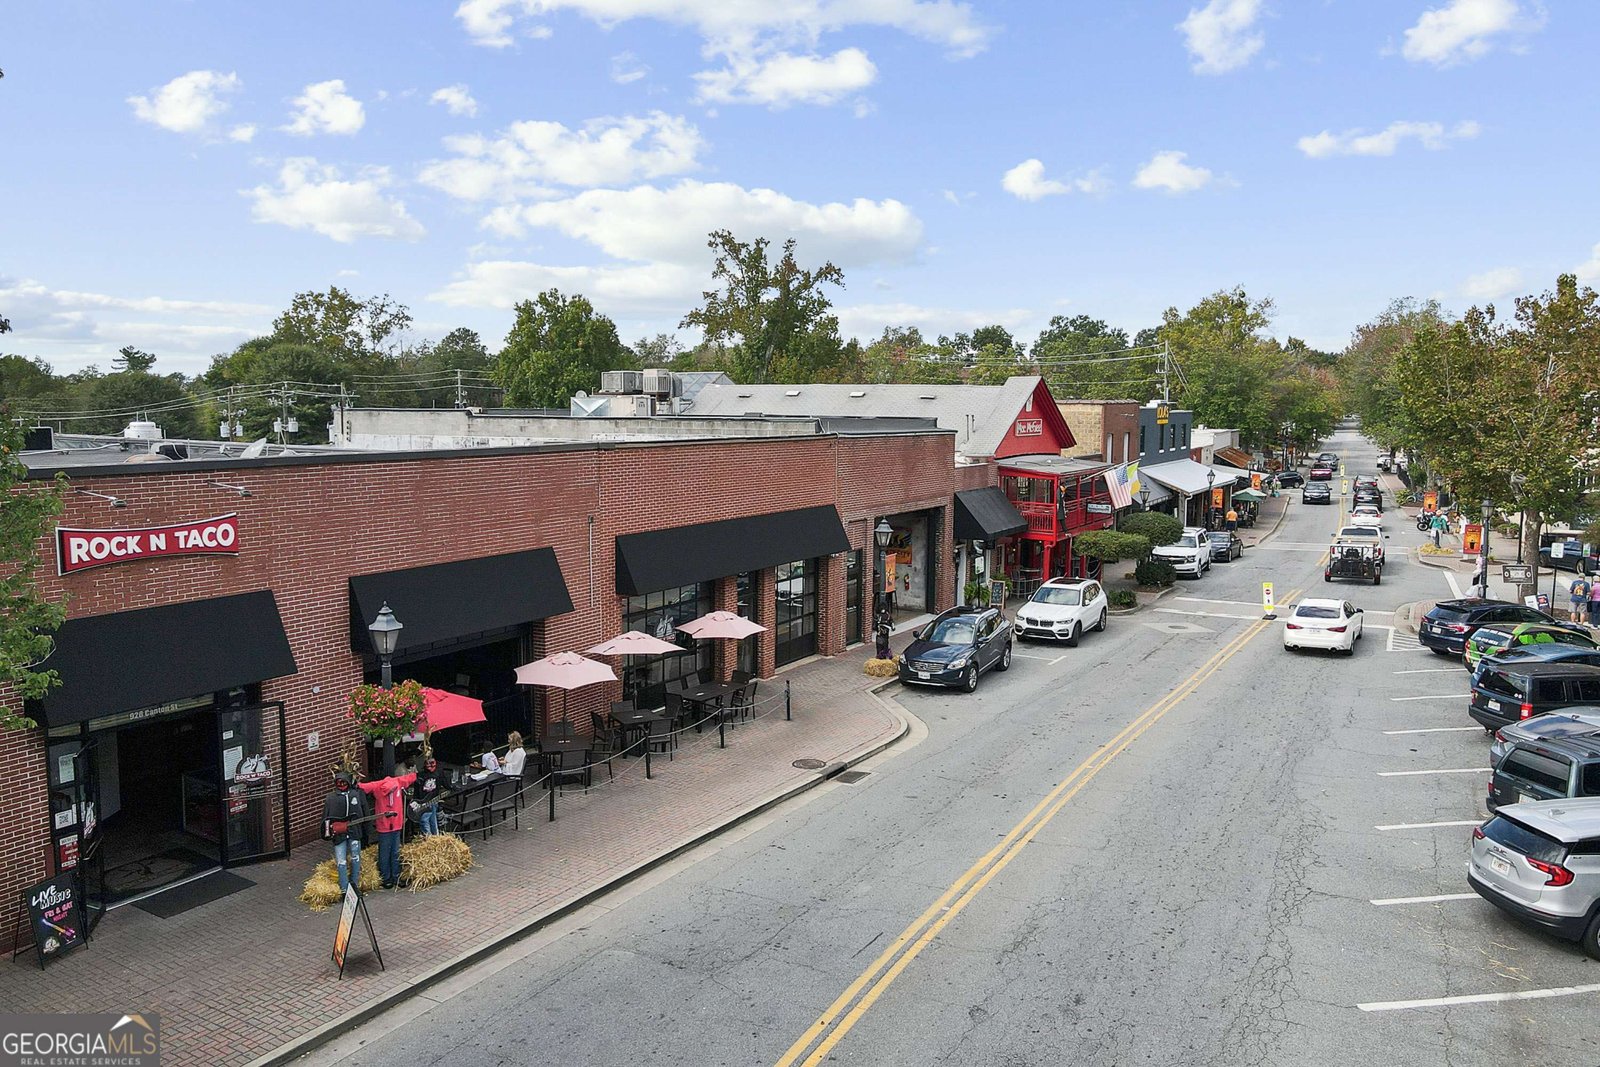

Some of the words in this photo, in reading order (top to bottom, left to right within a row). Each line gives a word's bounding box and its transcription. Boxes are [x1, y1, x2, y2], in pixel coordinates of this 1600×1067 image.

[69, 534, 143, 565] ROCK
[149, 532, 167, 552] N
[174, 523, 236, 550] TACO
[144, 705, 170, 717] Canton
[32, 885, 57, 907] LIVE
[40, 888, 71, 910] MUSIC
